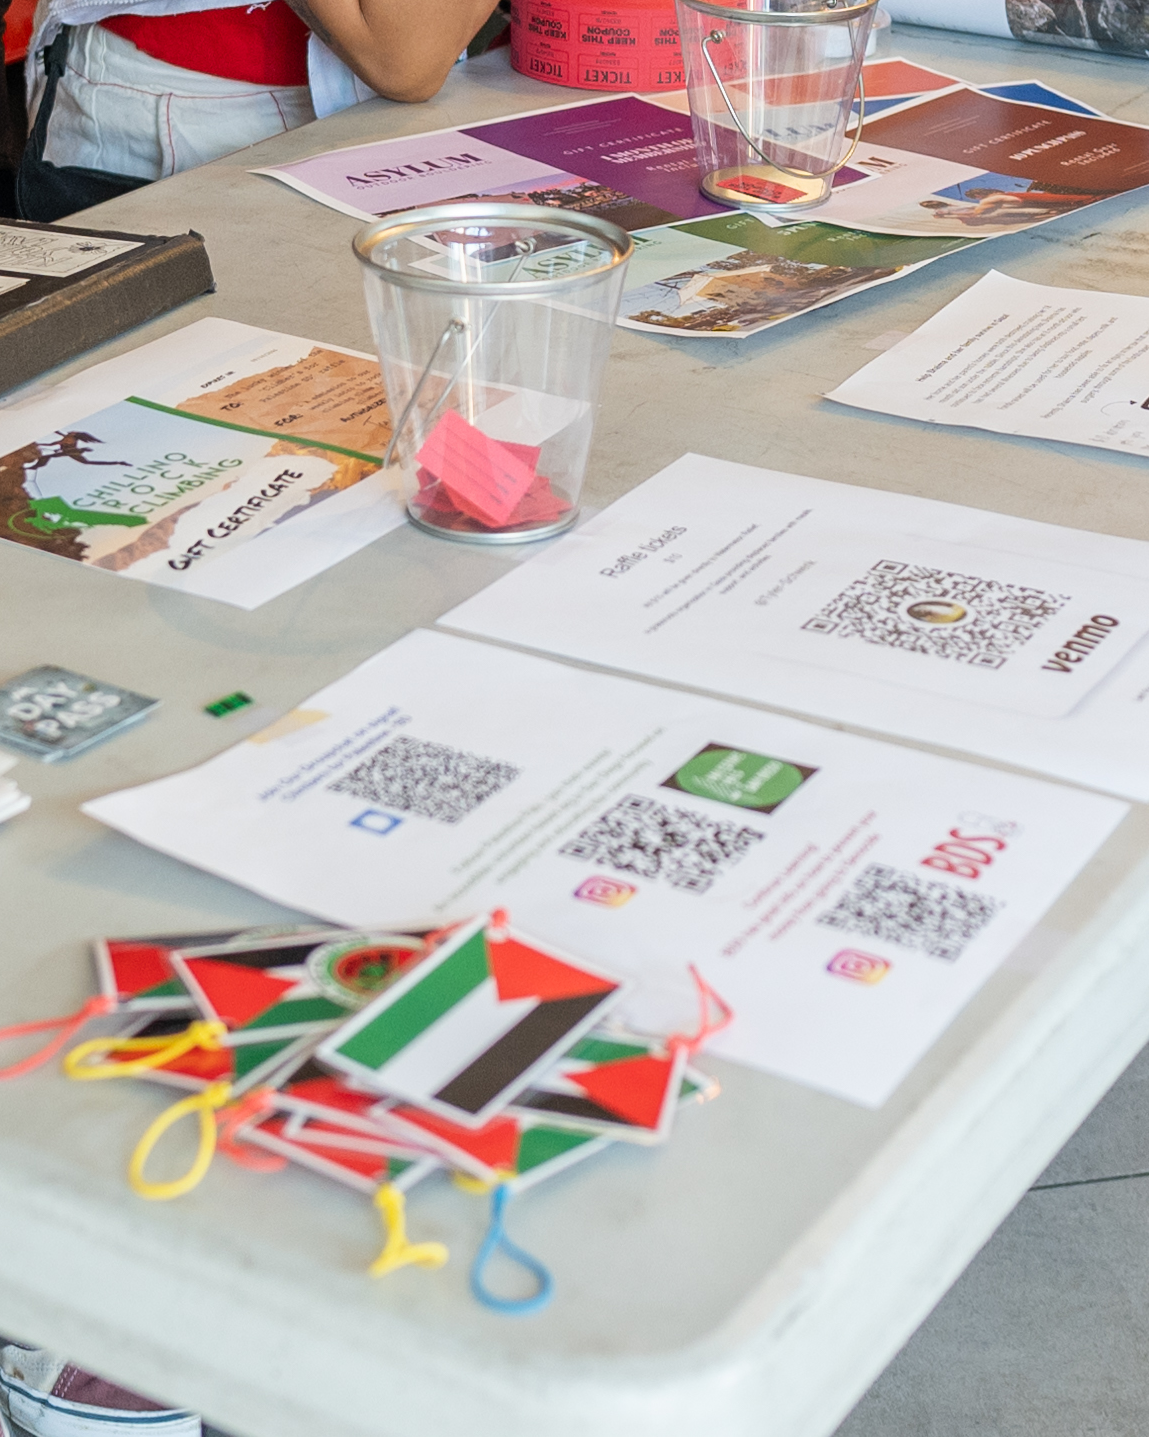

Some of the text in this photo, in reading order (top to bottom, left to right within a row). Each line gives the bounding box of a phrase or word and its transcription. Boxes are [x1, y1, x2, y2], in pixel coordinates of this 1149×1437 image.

[582, 35, 636, 46] KEEP THIS
[587, 27, 631, 37] COUPON
[654, 38, 678, 46] THIS
[530, 58, 563, 78] TICKET
[584, 70, 632, 84] TICKET
[599, 127, 684, 148] CERTIFICATE
[988, 119, 1053, 145] CERTIFICATE
[345, 152, 484, 187] ASYLUM
[726, 218, 755, 230] GIFT
[71, 451, 189, 509] CHILLINO
[101, 457, 208, 510] ROCK
[129, 456, 245, 516] CLIMBING
[168, 467, 305, 572] GIFT CERTIFICATE
[600, 525, 688, 579] Raffle tickets
[1040, 613, 1120, 674] venmo
[7, 680, 78, 721] DAY
[33, 690, 122, 739] PASS
[920, 827, 1008, 880] BDS
